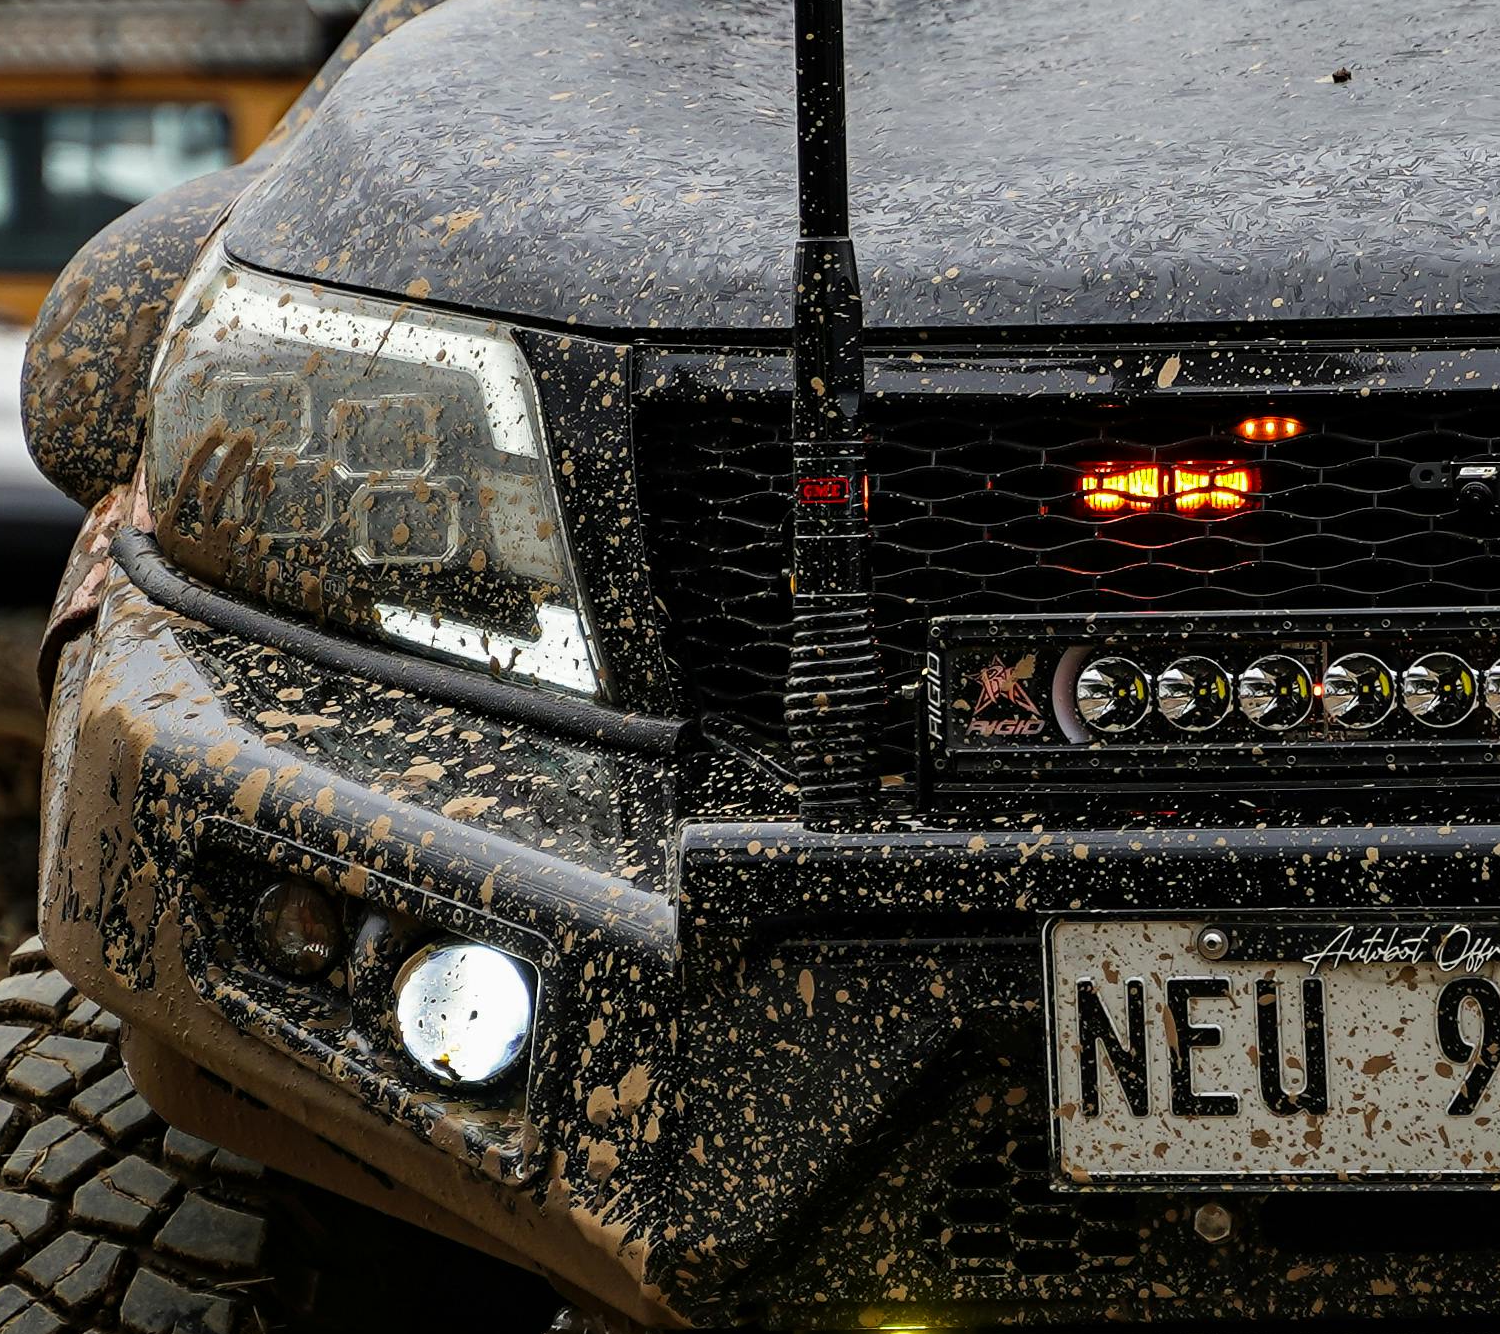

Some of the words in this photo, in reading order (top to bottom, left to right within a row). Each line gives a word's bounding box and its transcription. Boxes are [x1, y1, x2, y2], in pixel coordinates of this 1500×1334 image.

[927, 652, 943, 741] RIGID
[965, 719, 1046, 736] RIGID
[1302, 924, 1431, 975] Autobot
[1074, 975, 1328, 1119] NEU
